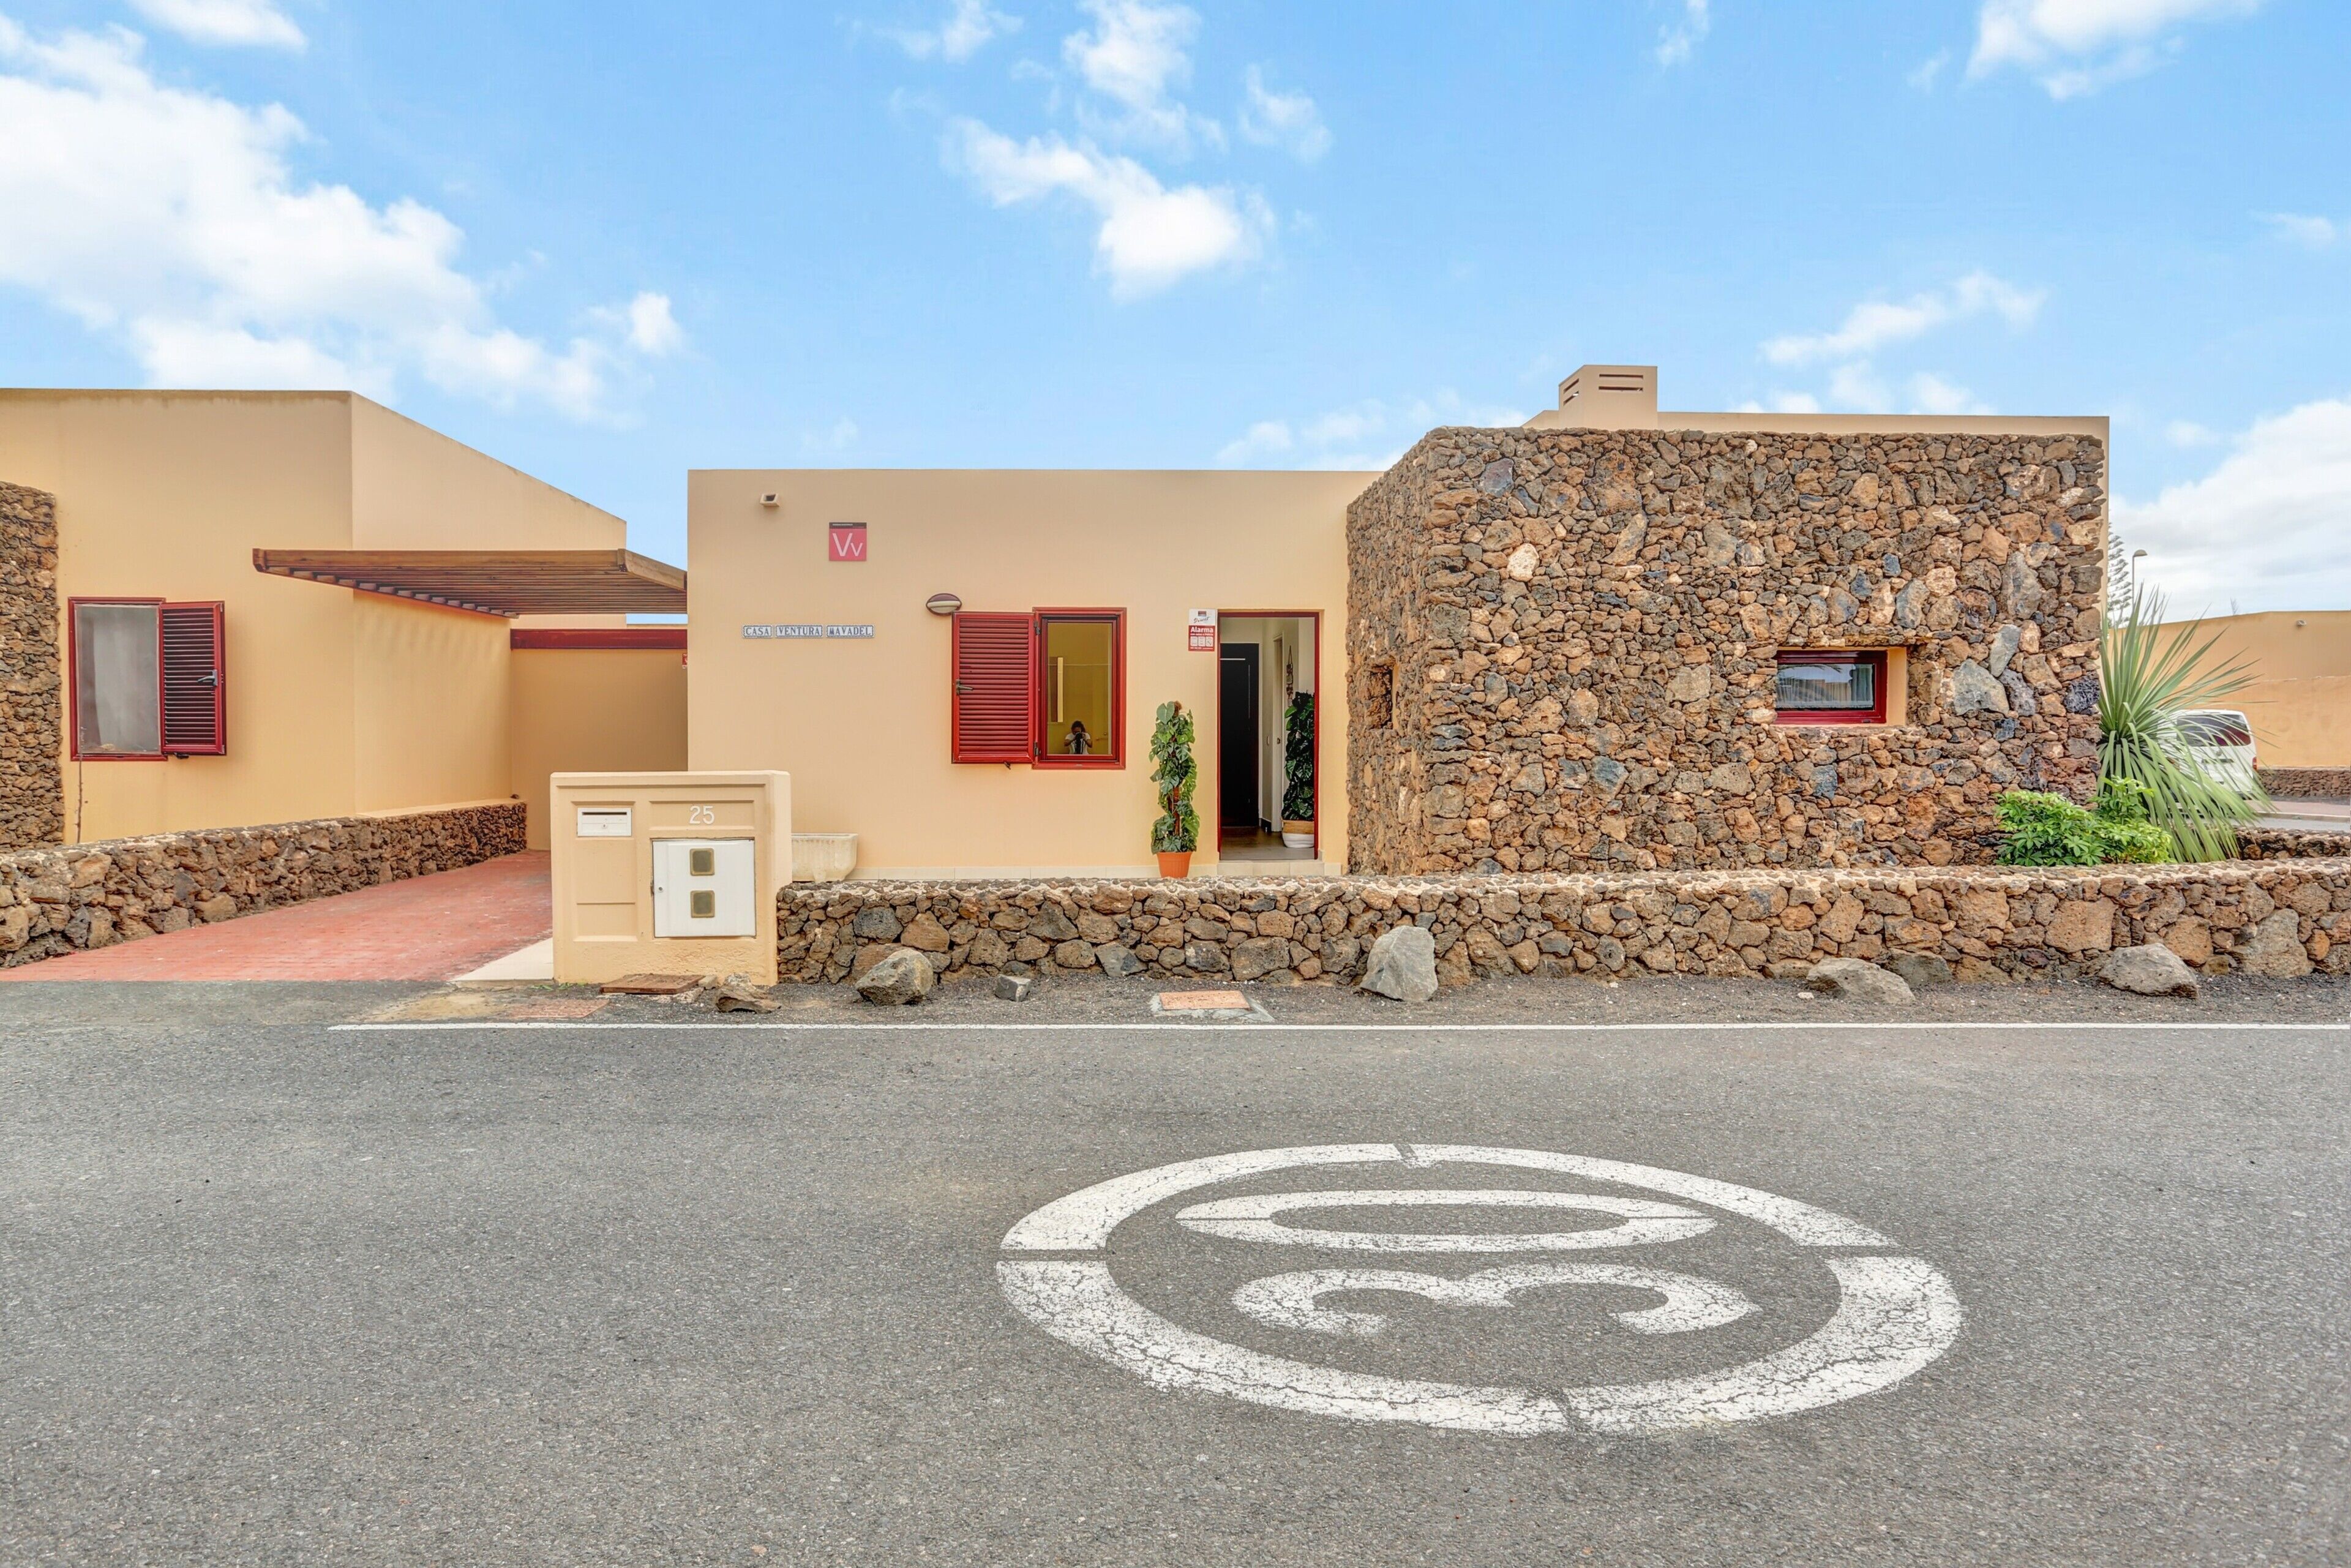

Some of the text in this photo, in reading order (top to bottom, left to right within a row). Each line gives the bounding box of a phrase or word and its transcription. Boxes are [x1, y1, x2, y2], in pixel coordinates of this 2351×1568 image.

[746, 627, 769, 636] CASA
[778, 626, 820, 636] VENTURA
[689, 805, 715, 824] 25
[1176, 1190, 1760, 1337] 30
